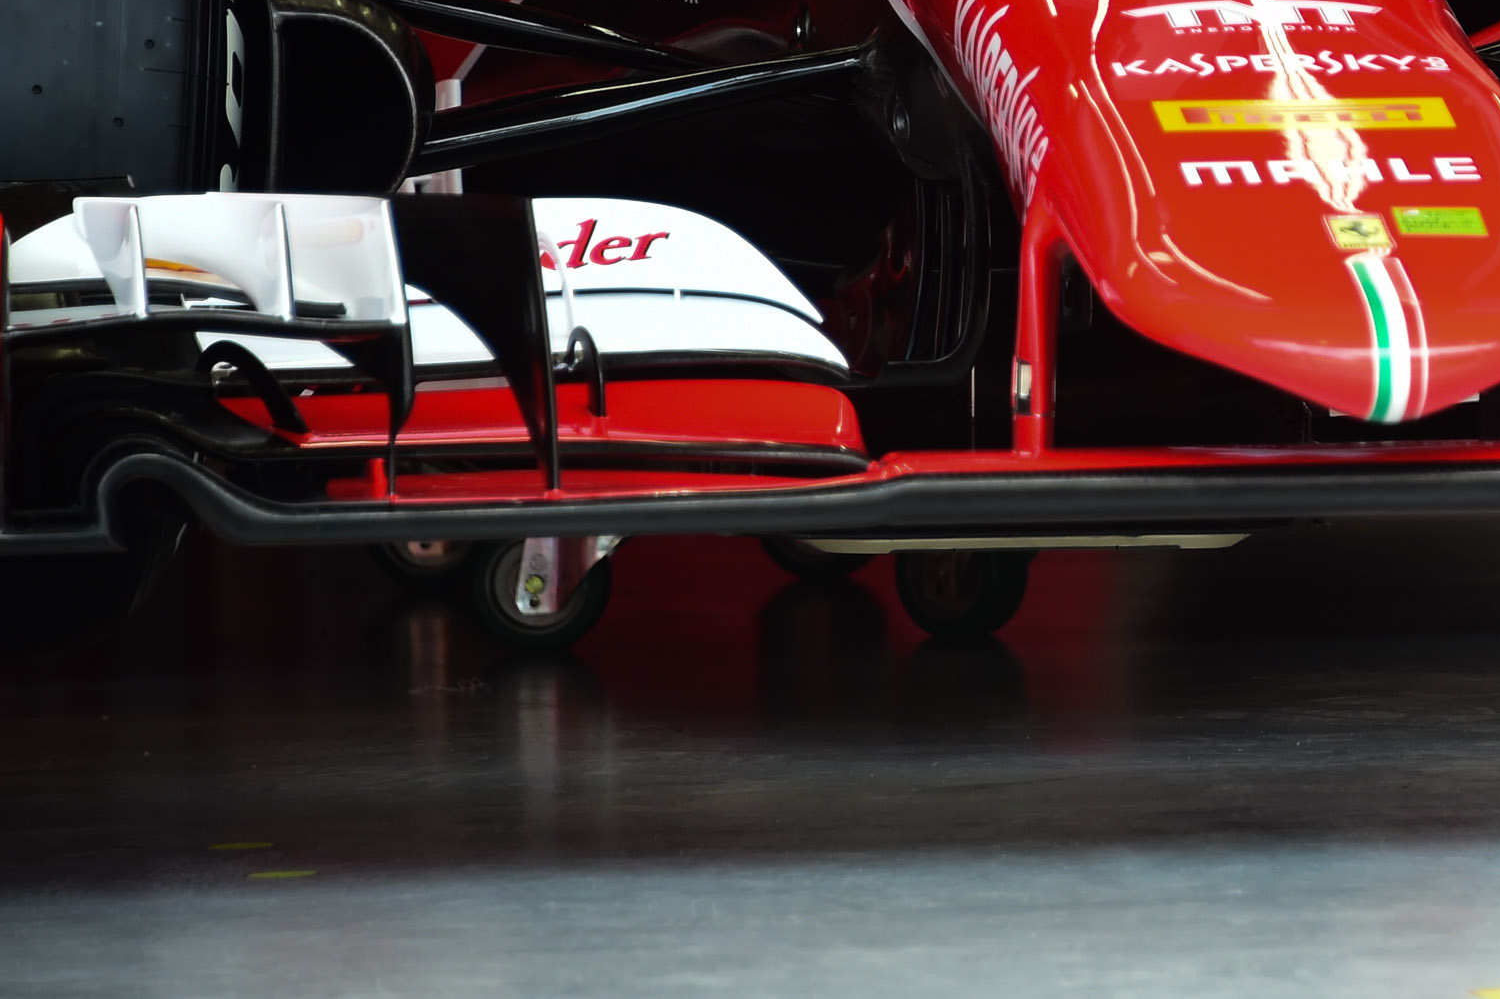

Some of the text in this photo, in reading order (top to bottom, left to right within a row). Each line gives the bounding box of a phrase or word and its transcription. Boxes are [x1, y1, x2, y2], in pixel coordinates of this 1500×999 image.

[1174, 24, 1358, 35] ENERG DRINK
[1111, 49, 1417, 77] KASPERSKY
[1179, 105, 1422, 124] PIRELLI
[1180, 156, 1483, 187] MAHLE
